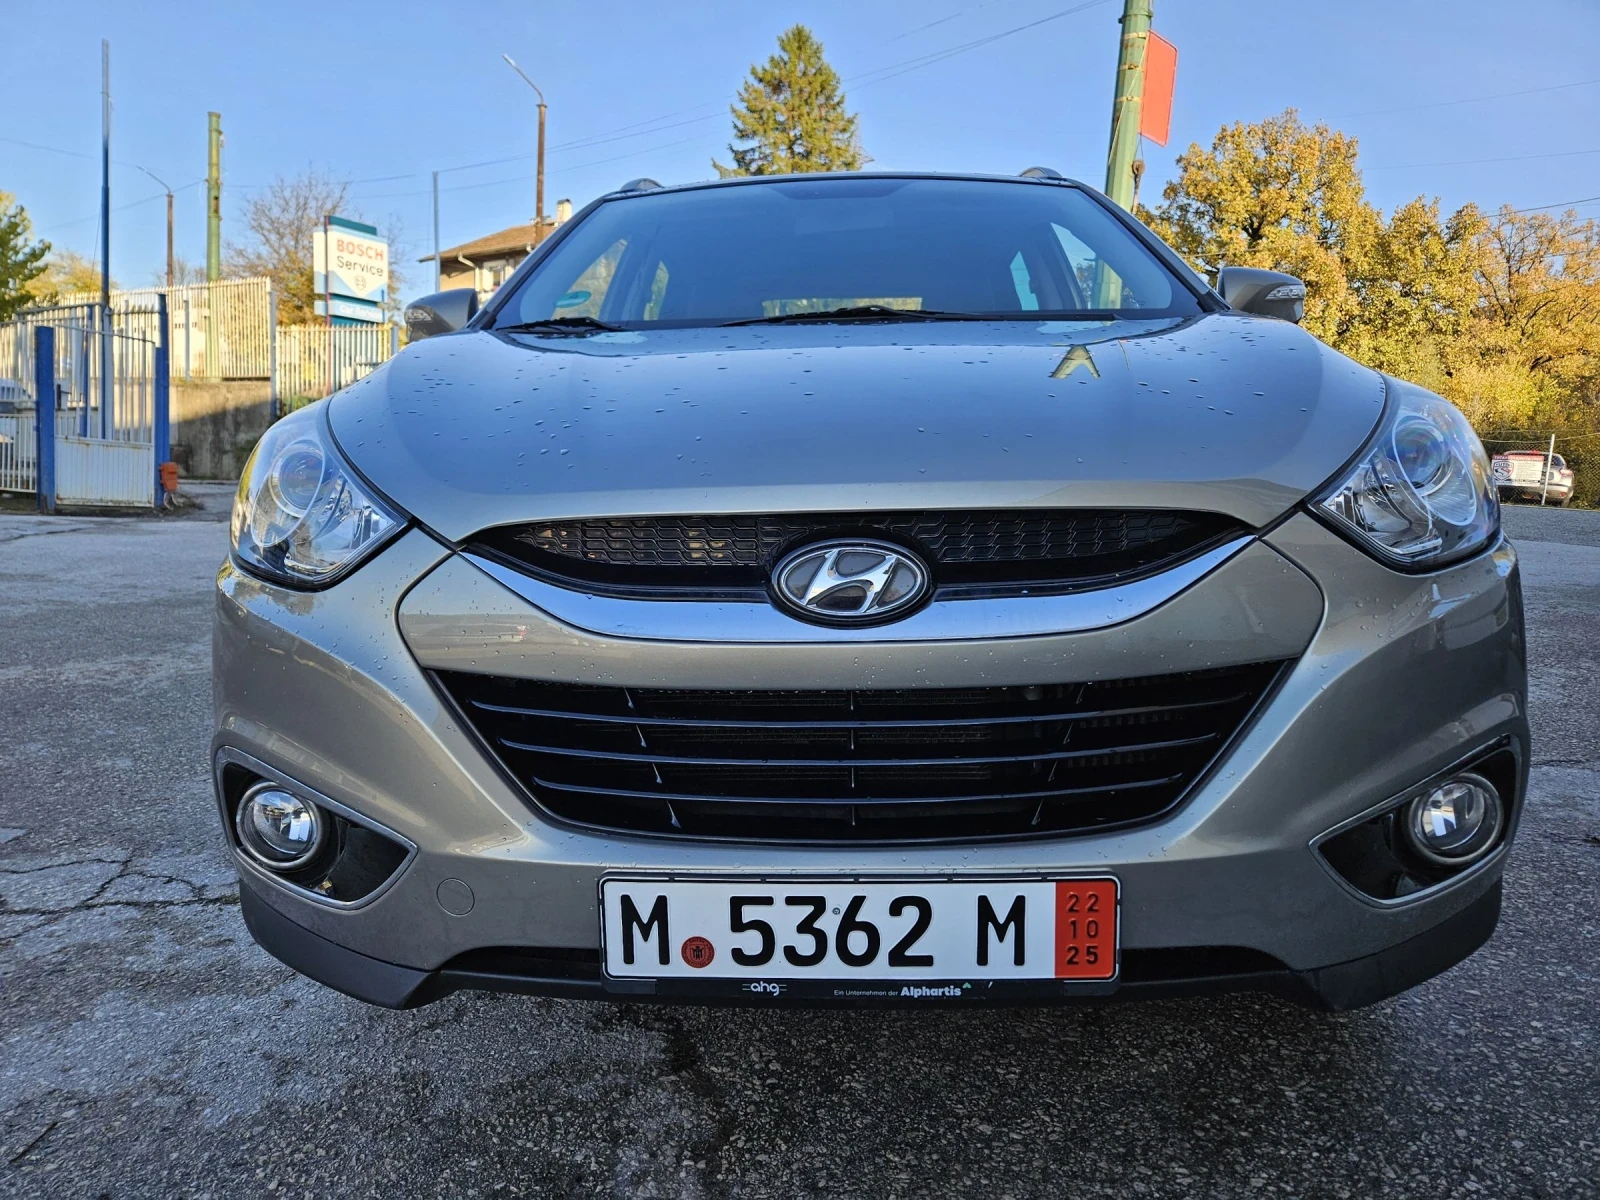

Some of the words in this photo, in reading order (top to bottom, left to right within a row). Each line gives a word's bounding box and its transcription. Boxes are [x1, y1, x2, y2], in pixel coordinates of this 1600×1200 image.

[336, 239, 384, 260] BOSCH
[336, 255, 384, 277] Service
[1066, 892, 1099, 913] 22
[620, 894, 670, 965] M
[730, 895, 934, 967] 5362
[976, 895, 1026, 966] M
[1068, 919, 1099, 940] 10
[1066, 945, 1099, 966] 25
[750, 981, 780, 997] ahg
[900, 985, 962, 998] Alphartis
